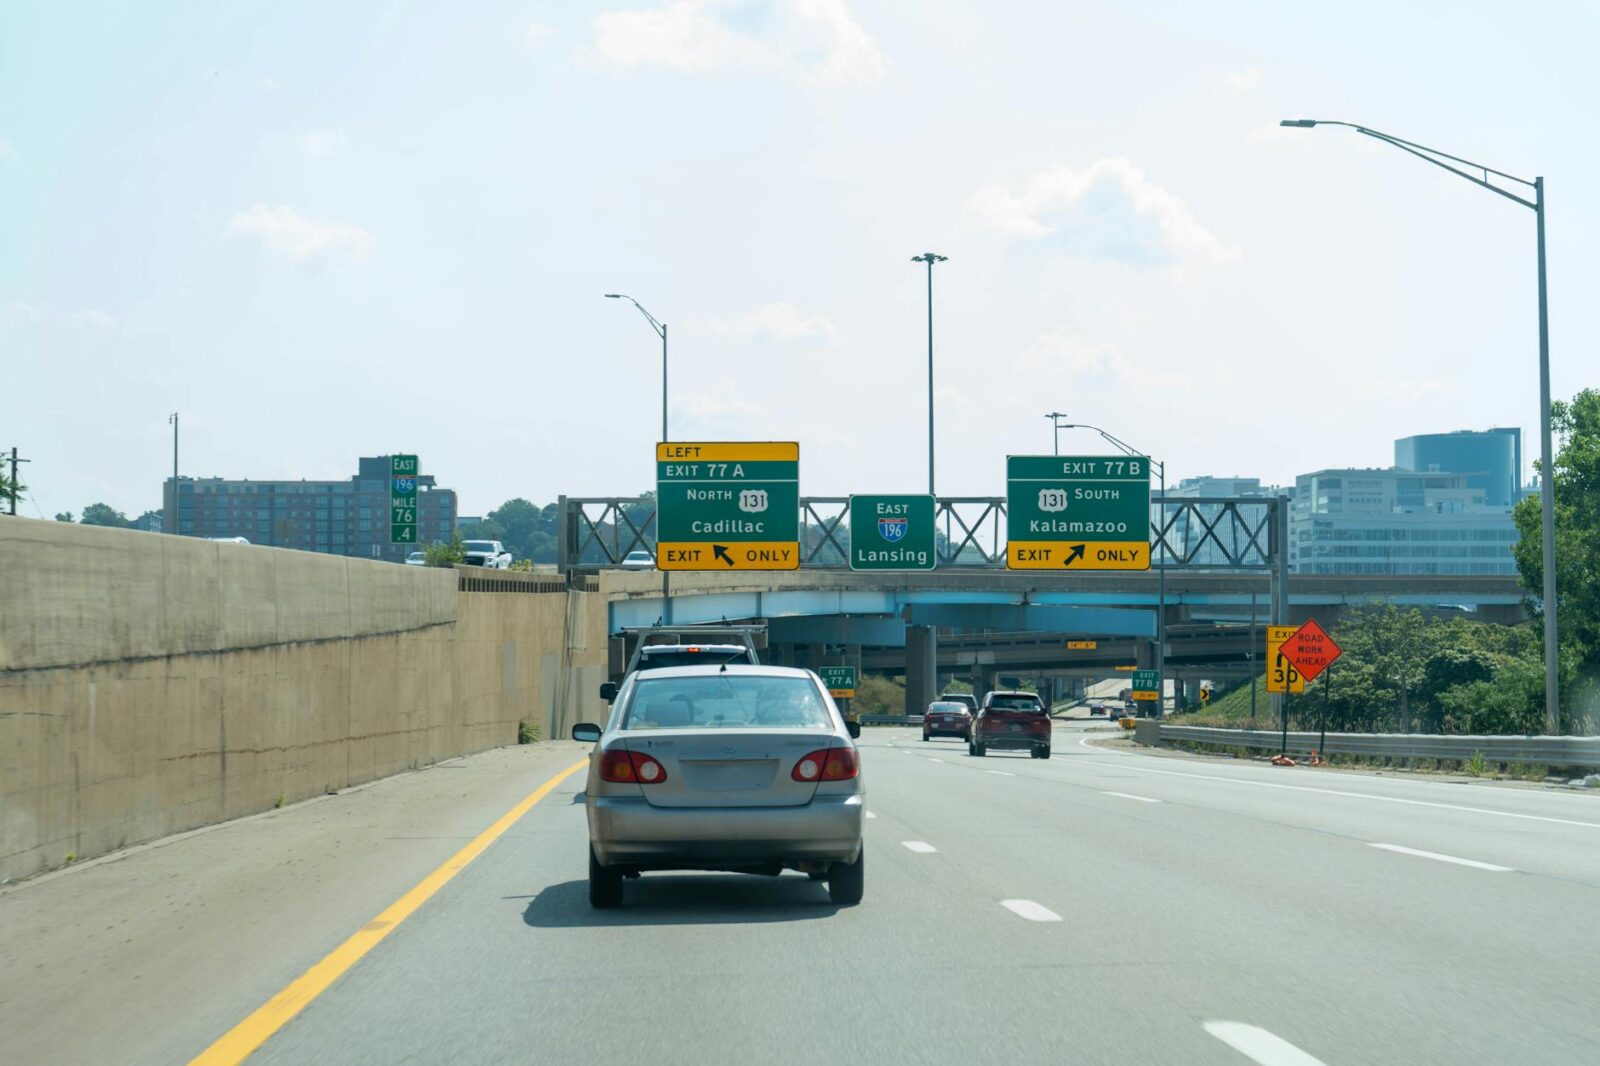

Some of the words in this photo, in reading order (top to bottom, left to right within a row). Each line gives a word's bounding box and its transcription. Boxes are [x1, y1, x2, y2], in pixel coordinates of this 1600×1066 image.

[666, 447, 701, 458] LEFT
[393, 458, 415, 471] EAST
[666, 465, 699, 477] EXIT
[707, 464, 728, 477] 77
[732, 464, 745, 477] A
[1063, 462, 1096, 474] EXIT
[1104, 462, 1125, 475] 77
[1129, 462, 1141, 475] B
[395, 479, 413, 490] 196
[393, 497, 416, 508] MILE
[687, 489, 732, 501] NORTH
[743, 494, 766, 508] 131
[1042, 493, 1064, 507] 131
[1074, 488, 1120, 500] SOUTH
[876, 503, 909, 514] EAST
[395, 509, 413, 523] 76
[691, 520, 764, 533] Cadillac
[884, 524, 902, 538] 196
[1030, 519, 1127, 533] Kalamazoo
[397, 527, 410, 541] .4
[667, 550, 702, 562] EXIT
[746, 550, 790, 562] ONLY
[858, 548, 927, 565] Lansing
[1017, 550, 1052, 561] EXIT
[1097, 549, 1139, 561] ONLY
[1298, 633, 1324, 643] ROAD
[1298, 645, 1324, 654] WORK
[1295, 657, 1326, 666] AHEAD
[1274, 669, 1298, 683] 30
